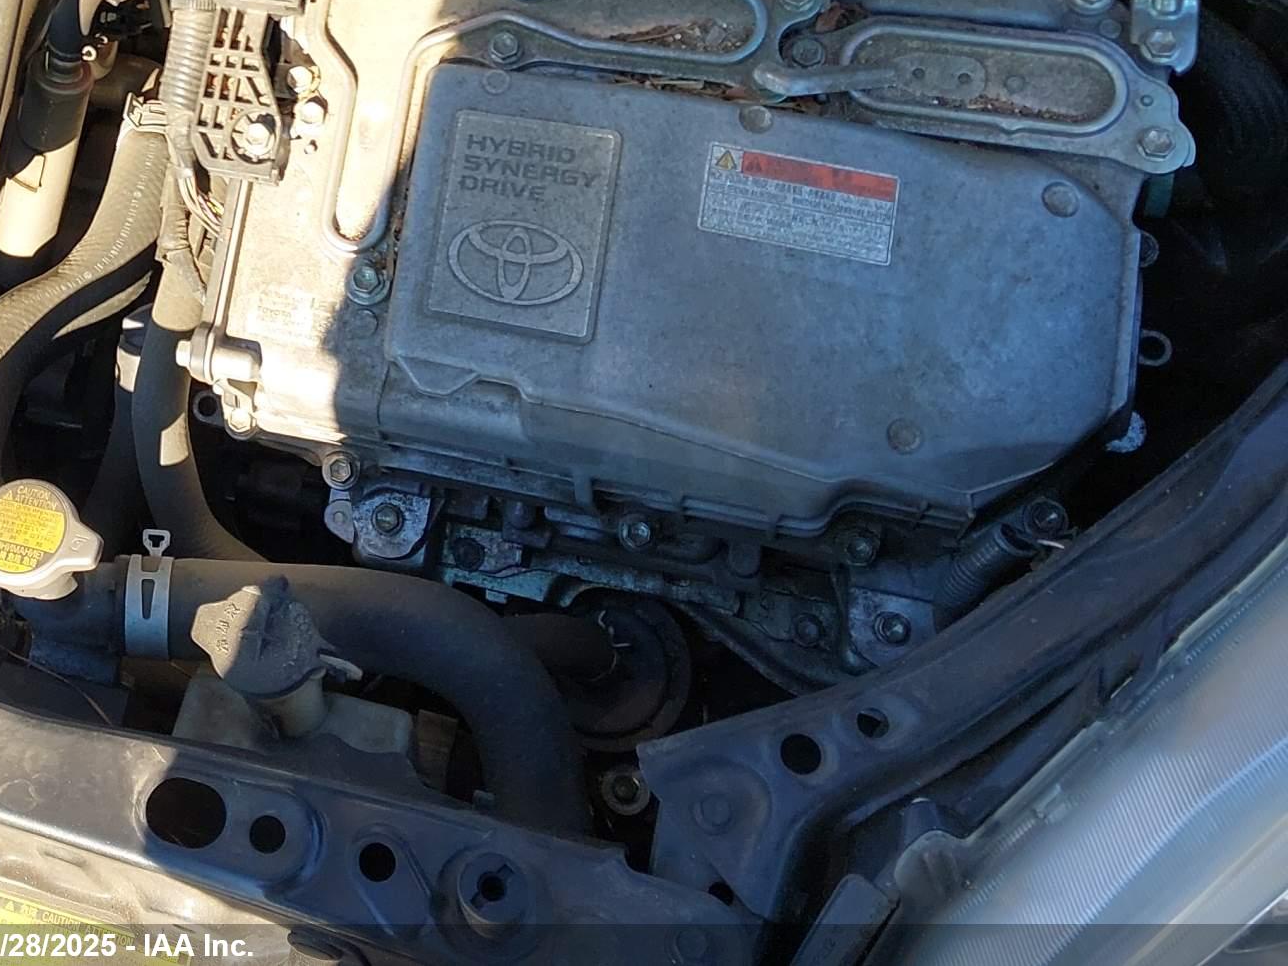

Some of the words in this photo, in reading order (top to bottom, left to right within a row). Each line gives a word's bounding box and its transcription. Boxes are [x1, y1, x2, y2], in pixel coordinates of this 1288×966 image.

[466, 134, 577, 165] HYBRID
[463, 153, 602, 188] SYNERGY
[459, 175, 548, 202] DRIVE
[15, 494, 58, 511] ATTENTION
[17, 485, 51, 500] CAUTION
[41, 910, 81, 931] CAUTION
